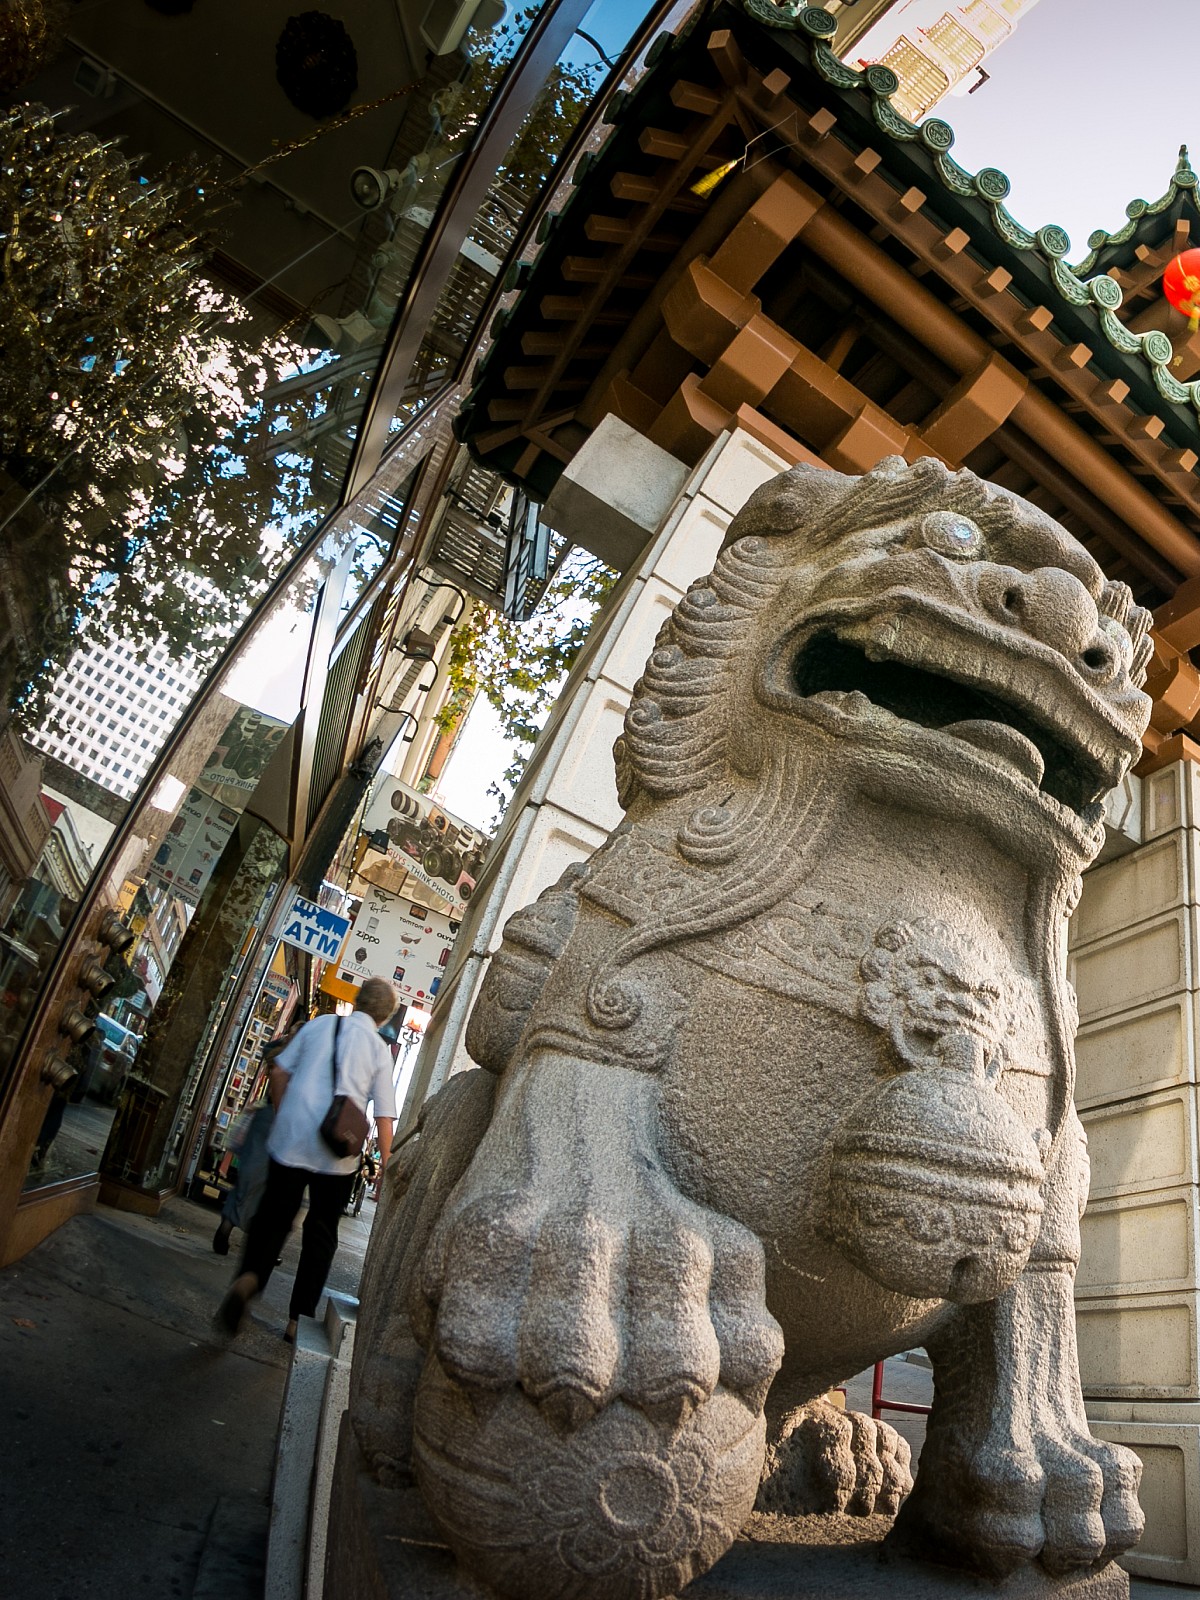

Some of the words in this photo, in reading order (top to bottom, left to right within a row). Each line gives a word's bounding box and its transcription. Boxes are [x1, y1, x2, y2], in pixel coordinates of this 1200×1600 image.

[387, 847, 407, 866] GUYS
[410, 864, 432, 885] THINK
[431, 880, 456, 904] PHOTO
[368, 901, 391, 914] Ray-Ban
[284, 920, 340, 958] ATM
[341, 958, 374, 976] CITIZEN
